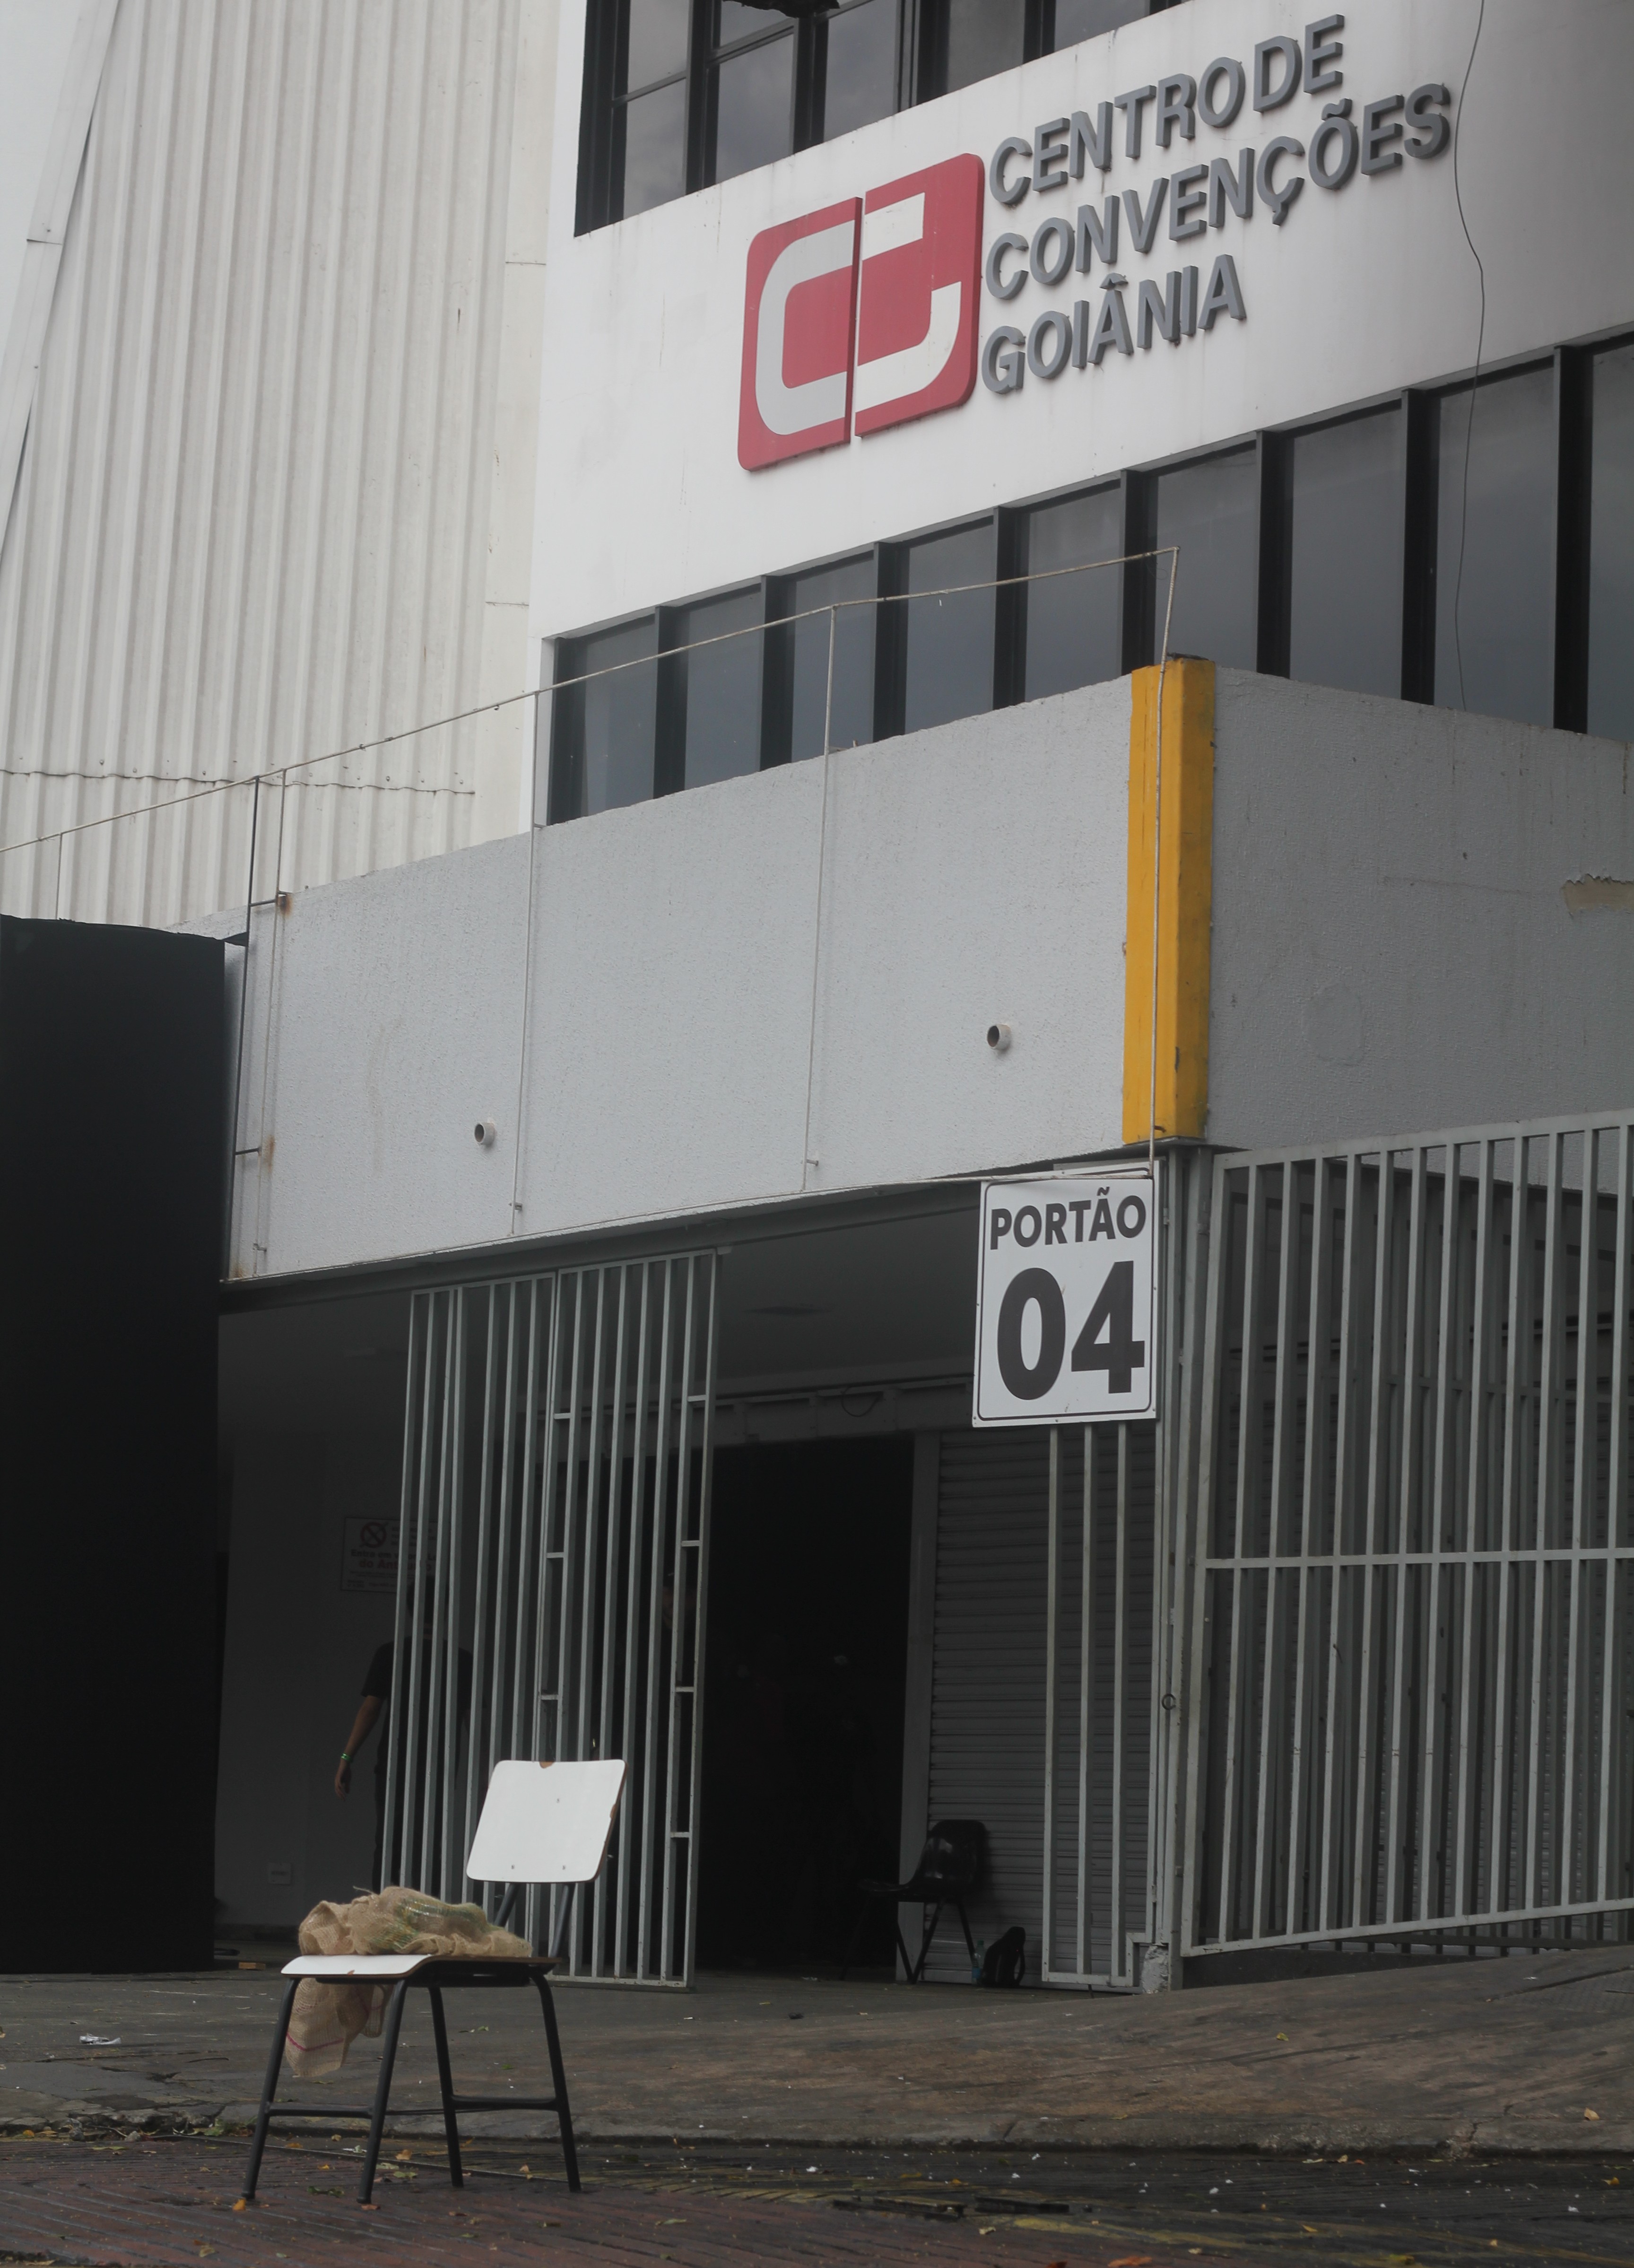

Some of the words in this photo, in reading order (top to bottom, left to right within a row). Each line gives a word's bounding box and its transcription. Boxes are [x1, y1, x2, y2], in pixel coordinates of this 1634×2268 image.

[989, 56, 1246, 205] CENTRO
[1253, 14, 1346, 113] DE
[985, 82, 1451, 300] CONVENÇÕES
[982, 253, 1246, 394] GOIÂNIA
[990, 1186, 1146, 1250] PORTÃO
[997, 1260, 1145, 1401] 04
